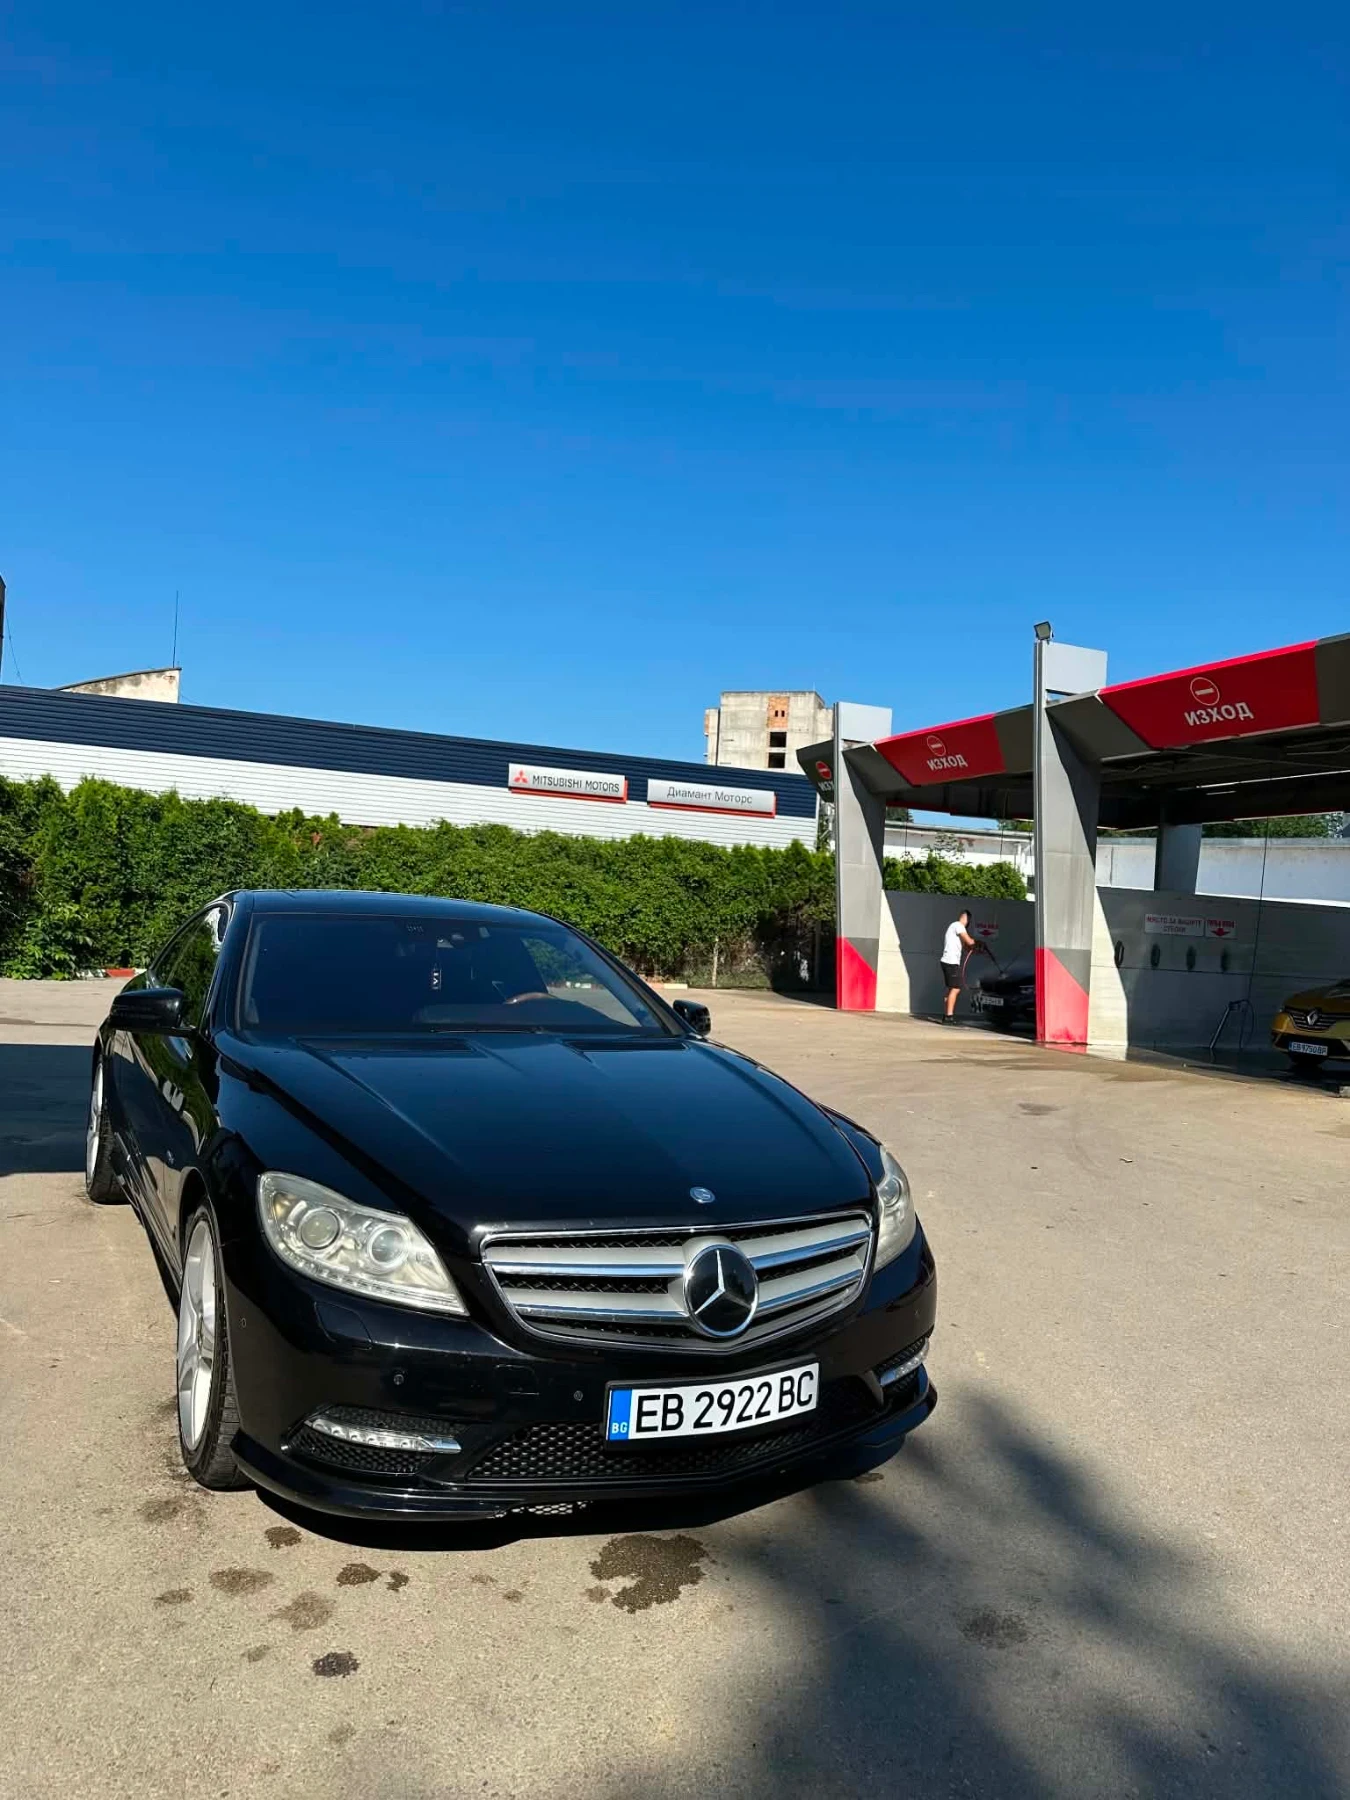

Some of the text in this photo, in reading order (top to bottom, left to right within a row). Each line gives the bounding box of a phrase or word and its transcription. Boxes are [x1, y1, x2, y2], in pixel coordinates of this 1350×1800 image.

[1184, 702, 1254, 726] ИЗХОД
[926, 754, 968, 771] ИЗХОД
[532, 775, 620, 793] MITSUBISHI MOTORS
[667, 786, 753, 805] Диамант Моторс
[636, 1371, 814, 1433] EB 2922 BC
[611, 1422, 627, 1434] BG
